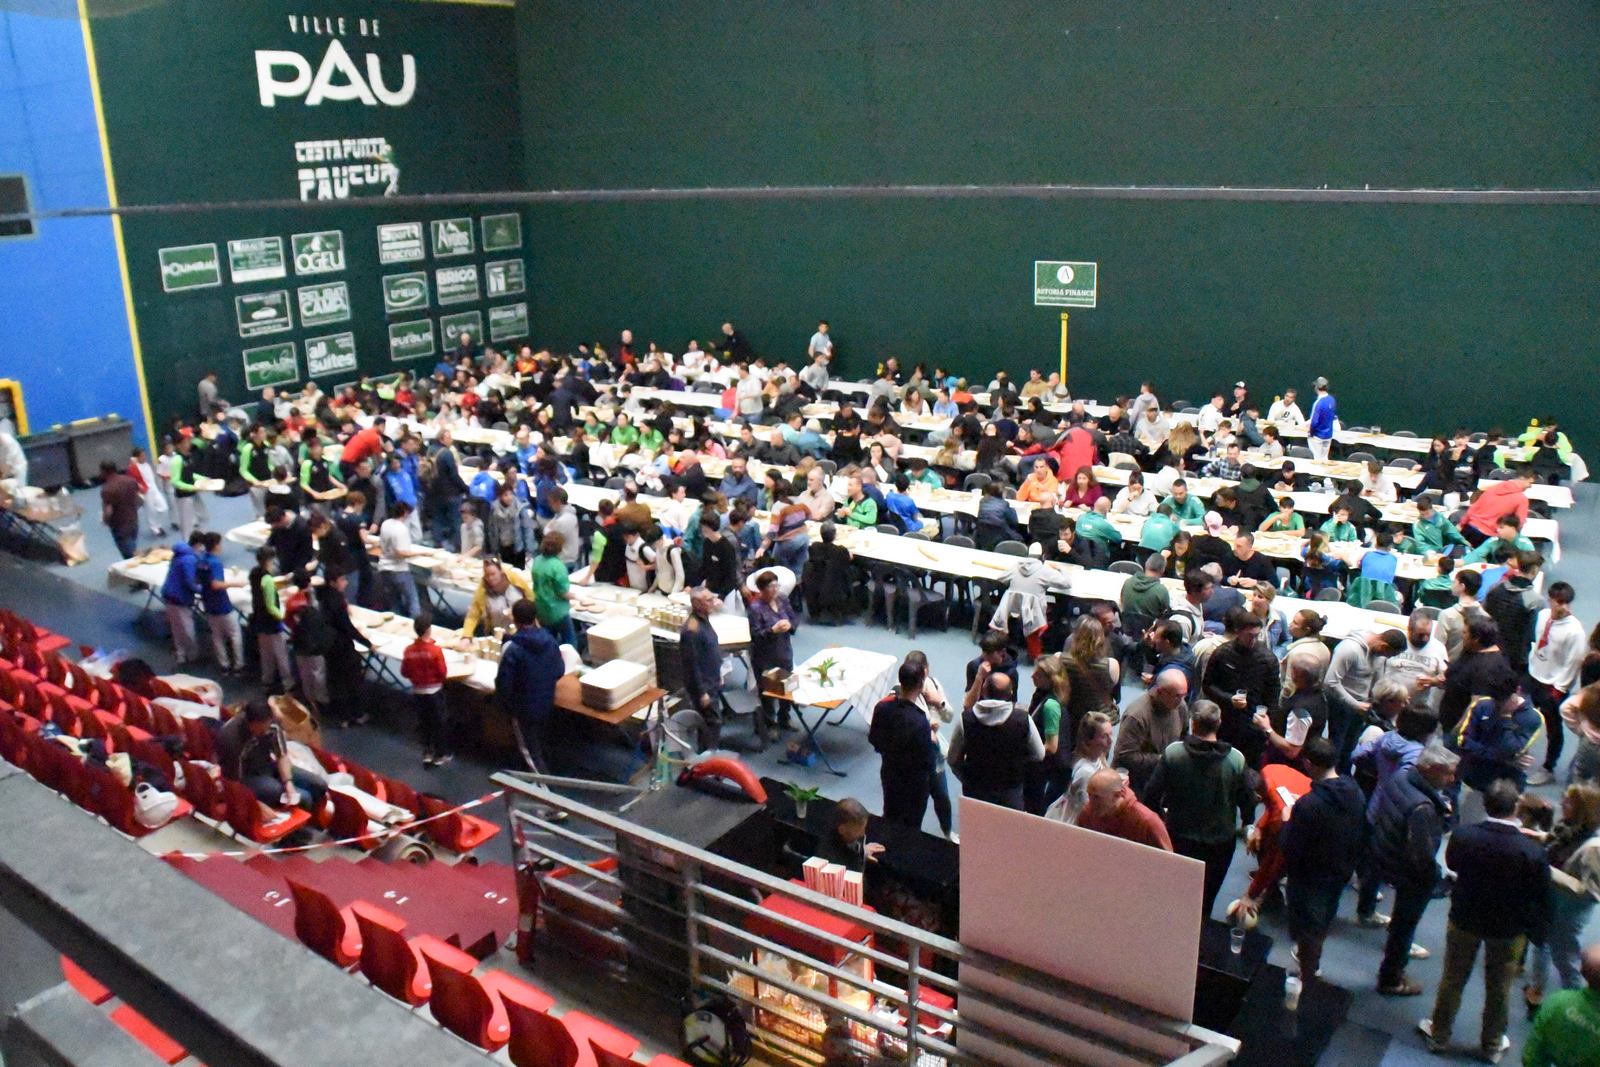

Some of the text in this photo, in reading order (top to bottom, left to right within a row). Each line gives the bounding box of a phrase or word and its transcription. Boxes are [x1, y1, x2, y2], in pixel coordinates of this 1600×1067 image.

[288, 14, 380, 37] VILLE DE
[255, 38, 417, 107] PAU
[294, 140, 343, 163] CESTA
[298, 166, 349, 202] PAU
